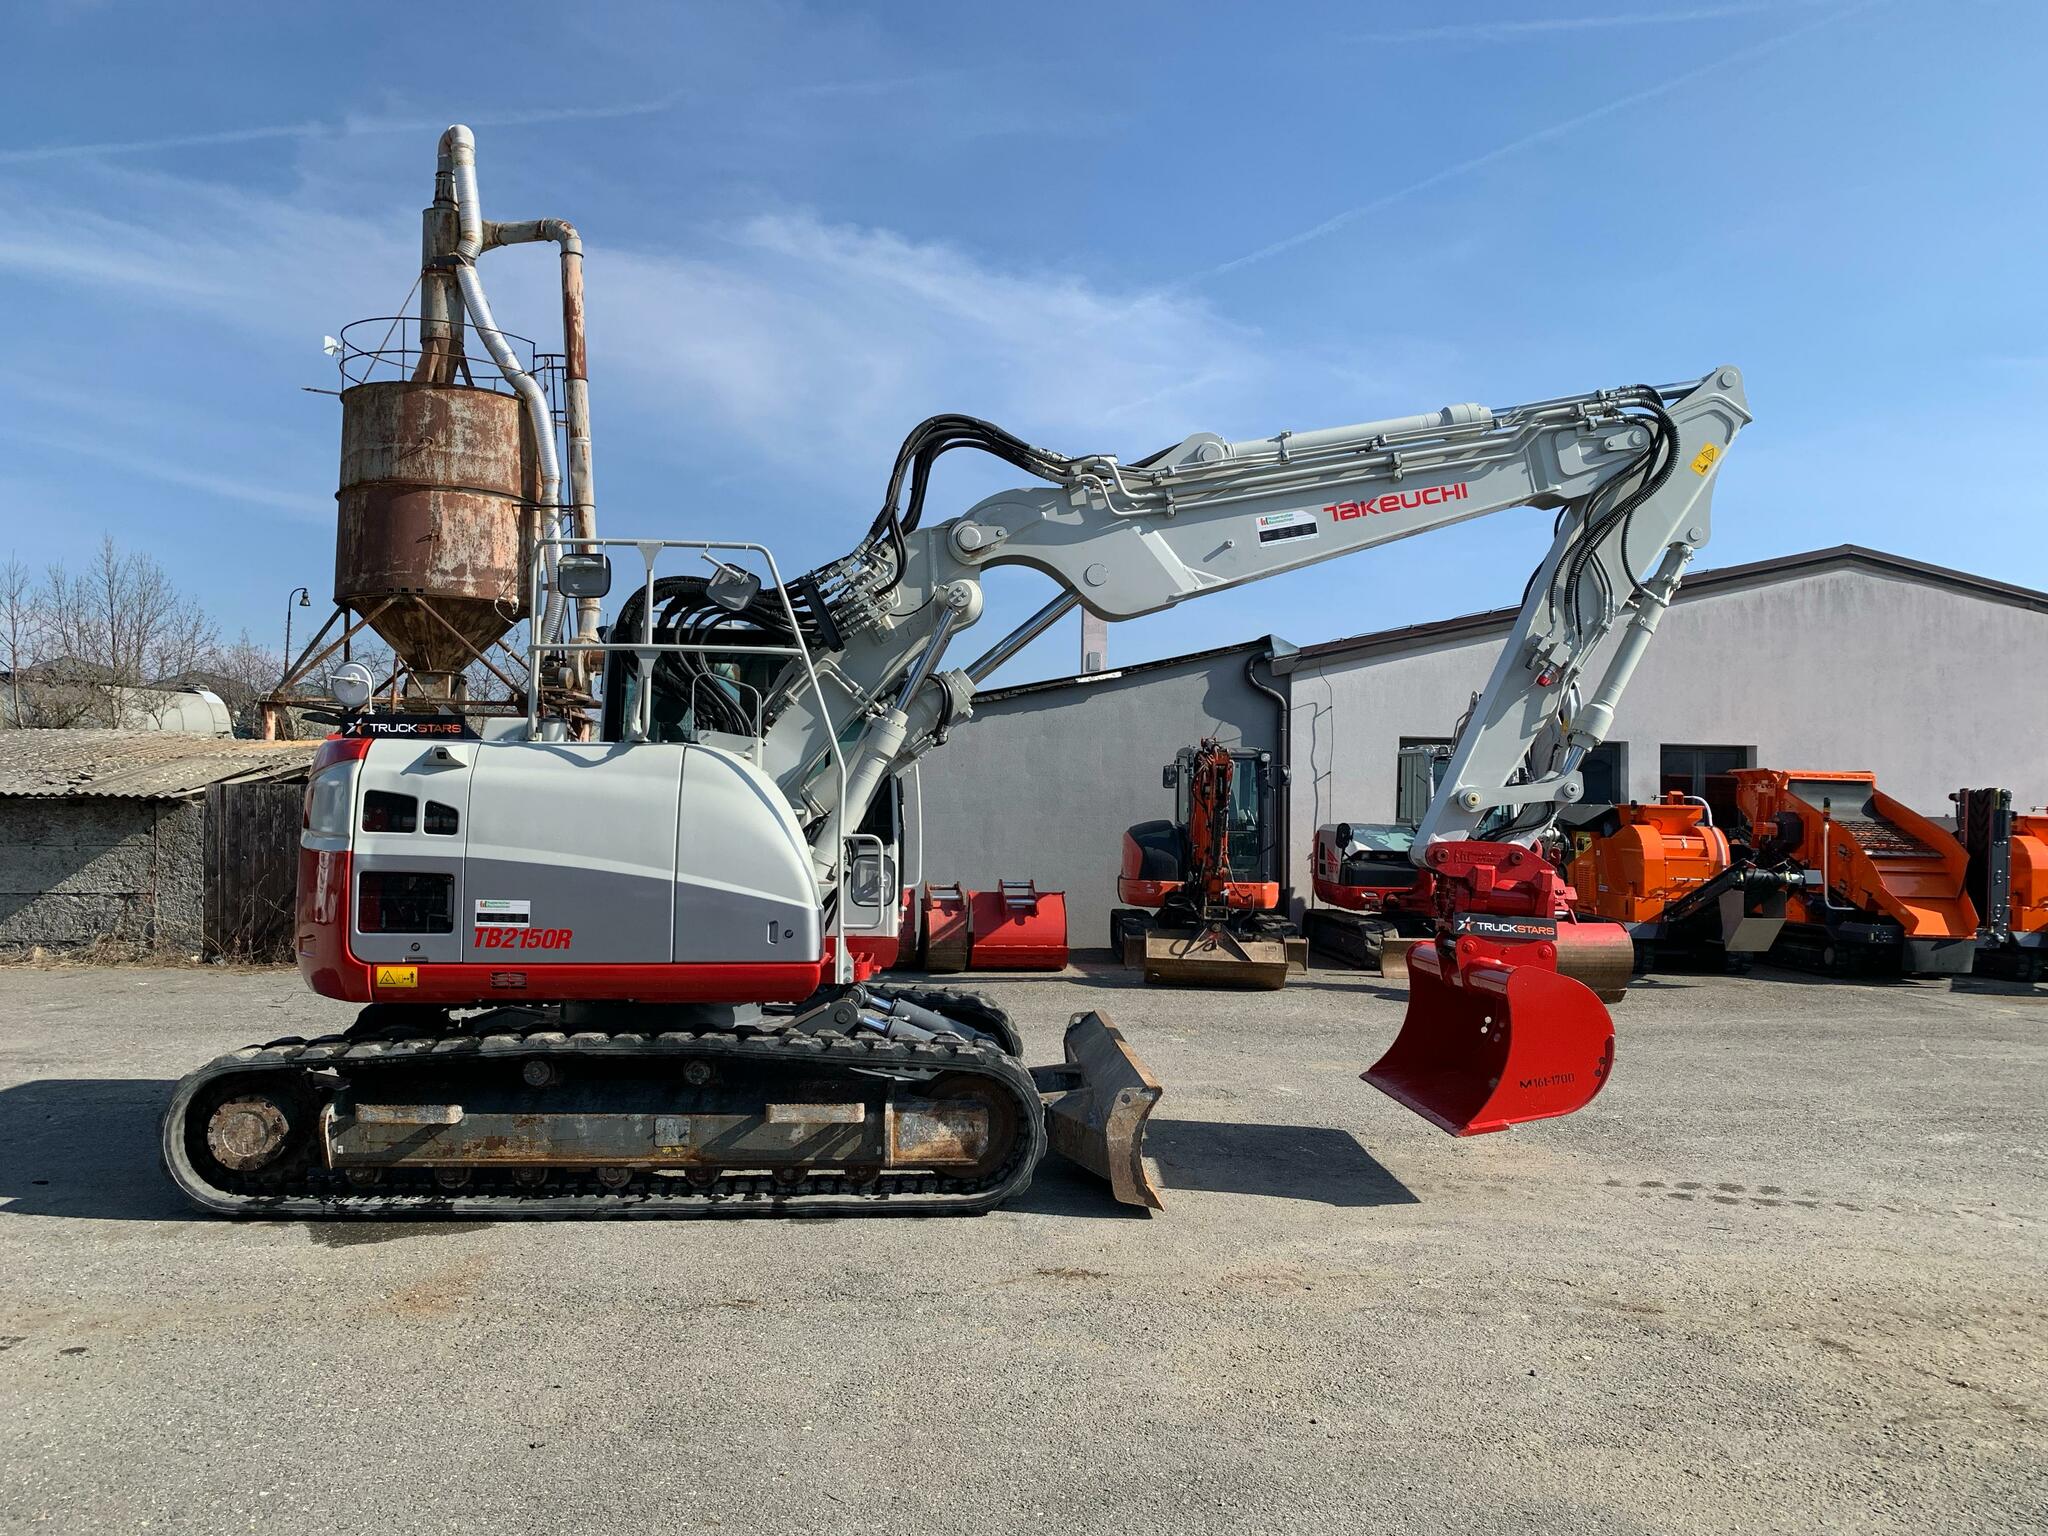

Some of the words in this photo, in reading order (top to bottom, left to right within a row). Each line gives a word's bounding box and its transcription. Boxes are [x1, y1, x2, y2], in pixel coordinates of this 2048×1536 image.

[369, 723, 462, 734] TRUCKSTARS
[1476, 922, 1555, 936] TRUCKSTARS
[474, 927, 573, 949] TB2150R
